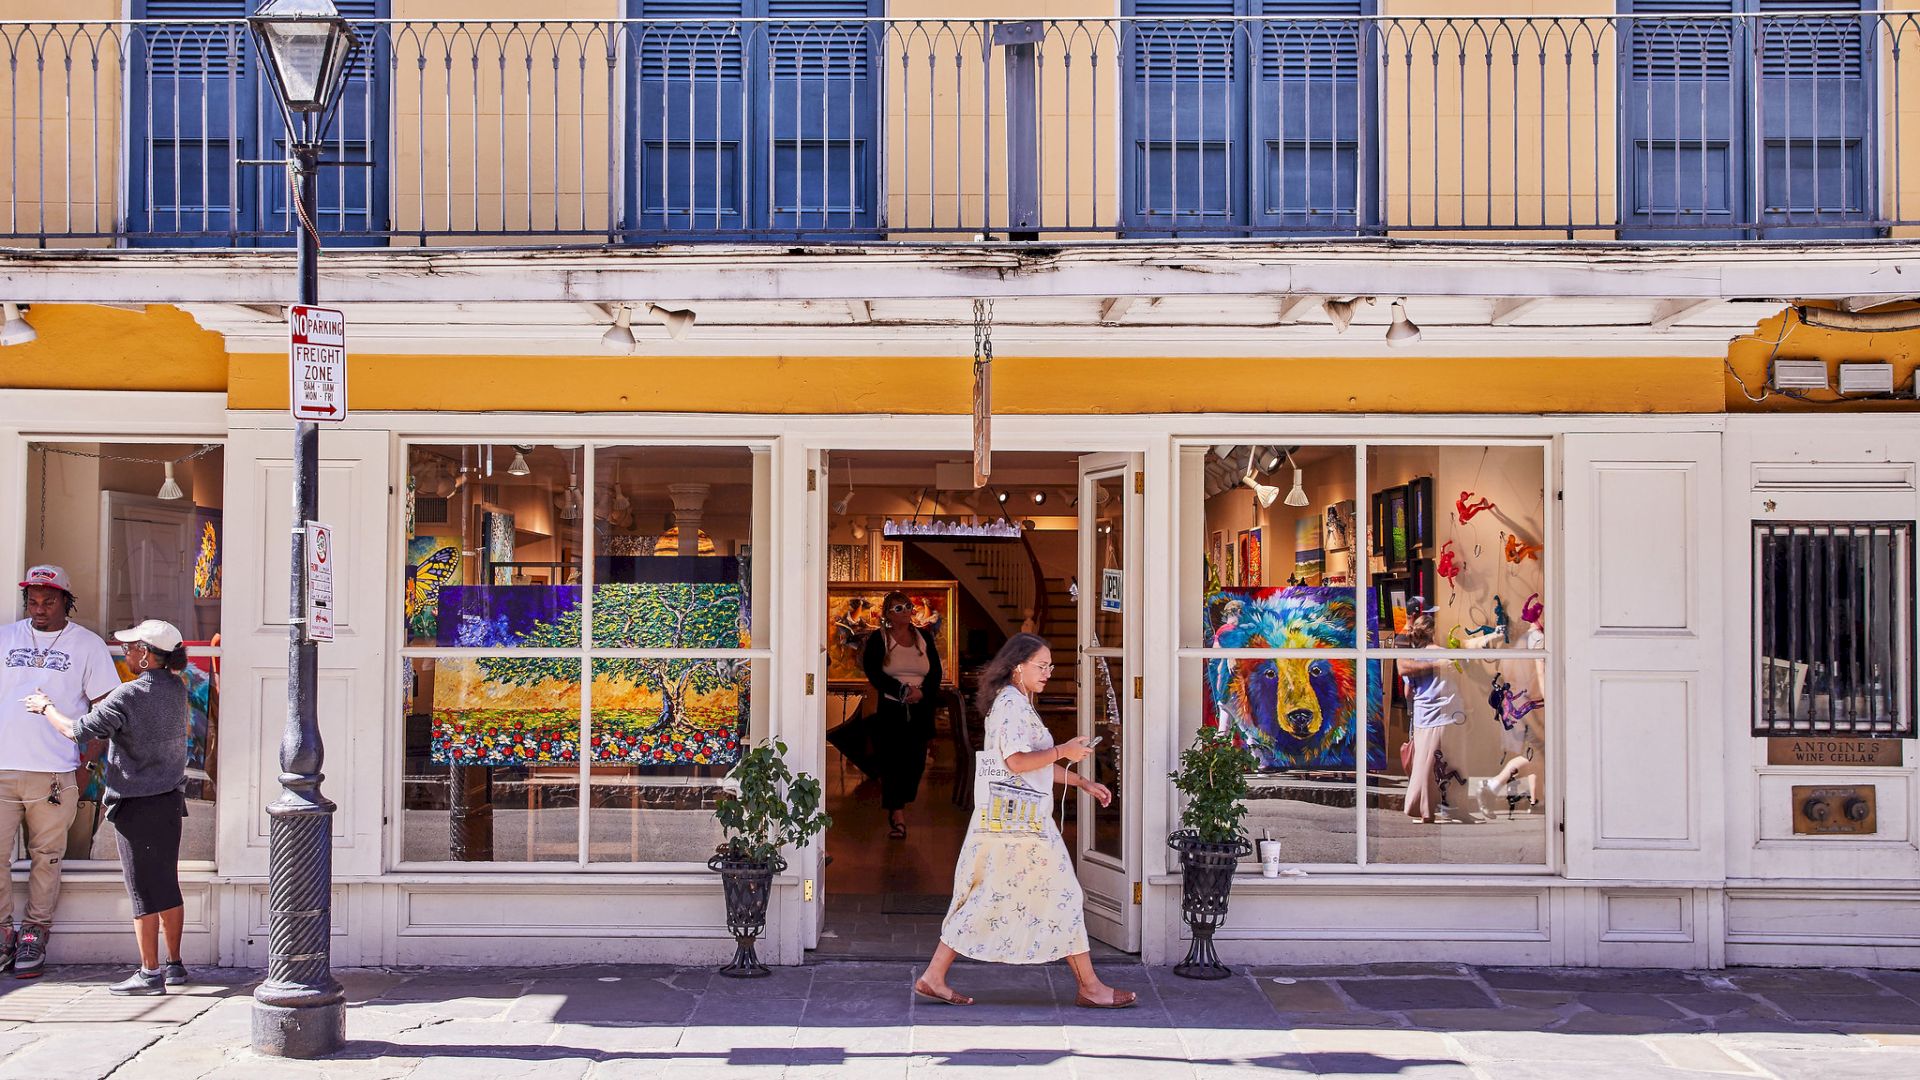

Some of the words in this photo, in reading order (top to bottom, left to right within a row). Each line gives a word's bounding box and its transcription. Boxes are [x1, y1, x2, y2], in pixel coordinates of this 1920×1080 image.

[292, 314, 307, 337] NO
[308, 319, 343, 336] PARKING
[297, 347, 340, 363] FREIGHT
[304, 365, 333, 381] ZONE
[303, 381, 315, 392] 8AM
[322, 383, 335, 393] 11AM
[305, 391, 317, 401] MON
[324, 392, 334, 402] FRI
[1105, 574, 1120, 599] OPEN
[1796, 753, 1825, 762] WINE
[1830, 753, 1876, 763] CELLAR
